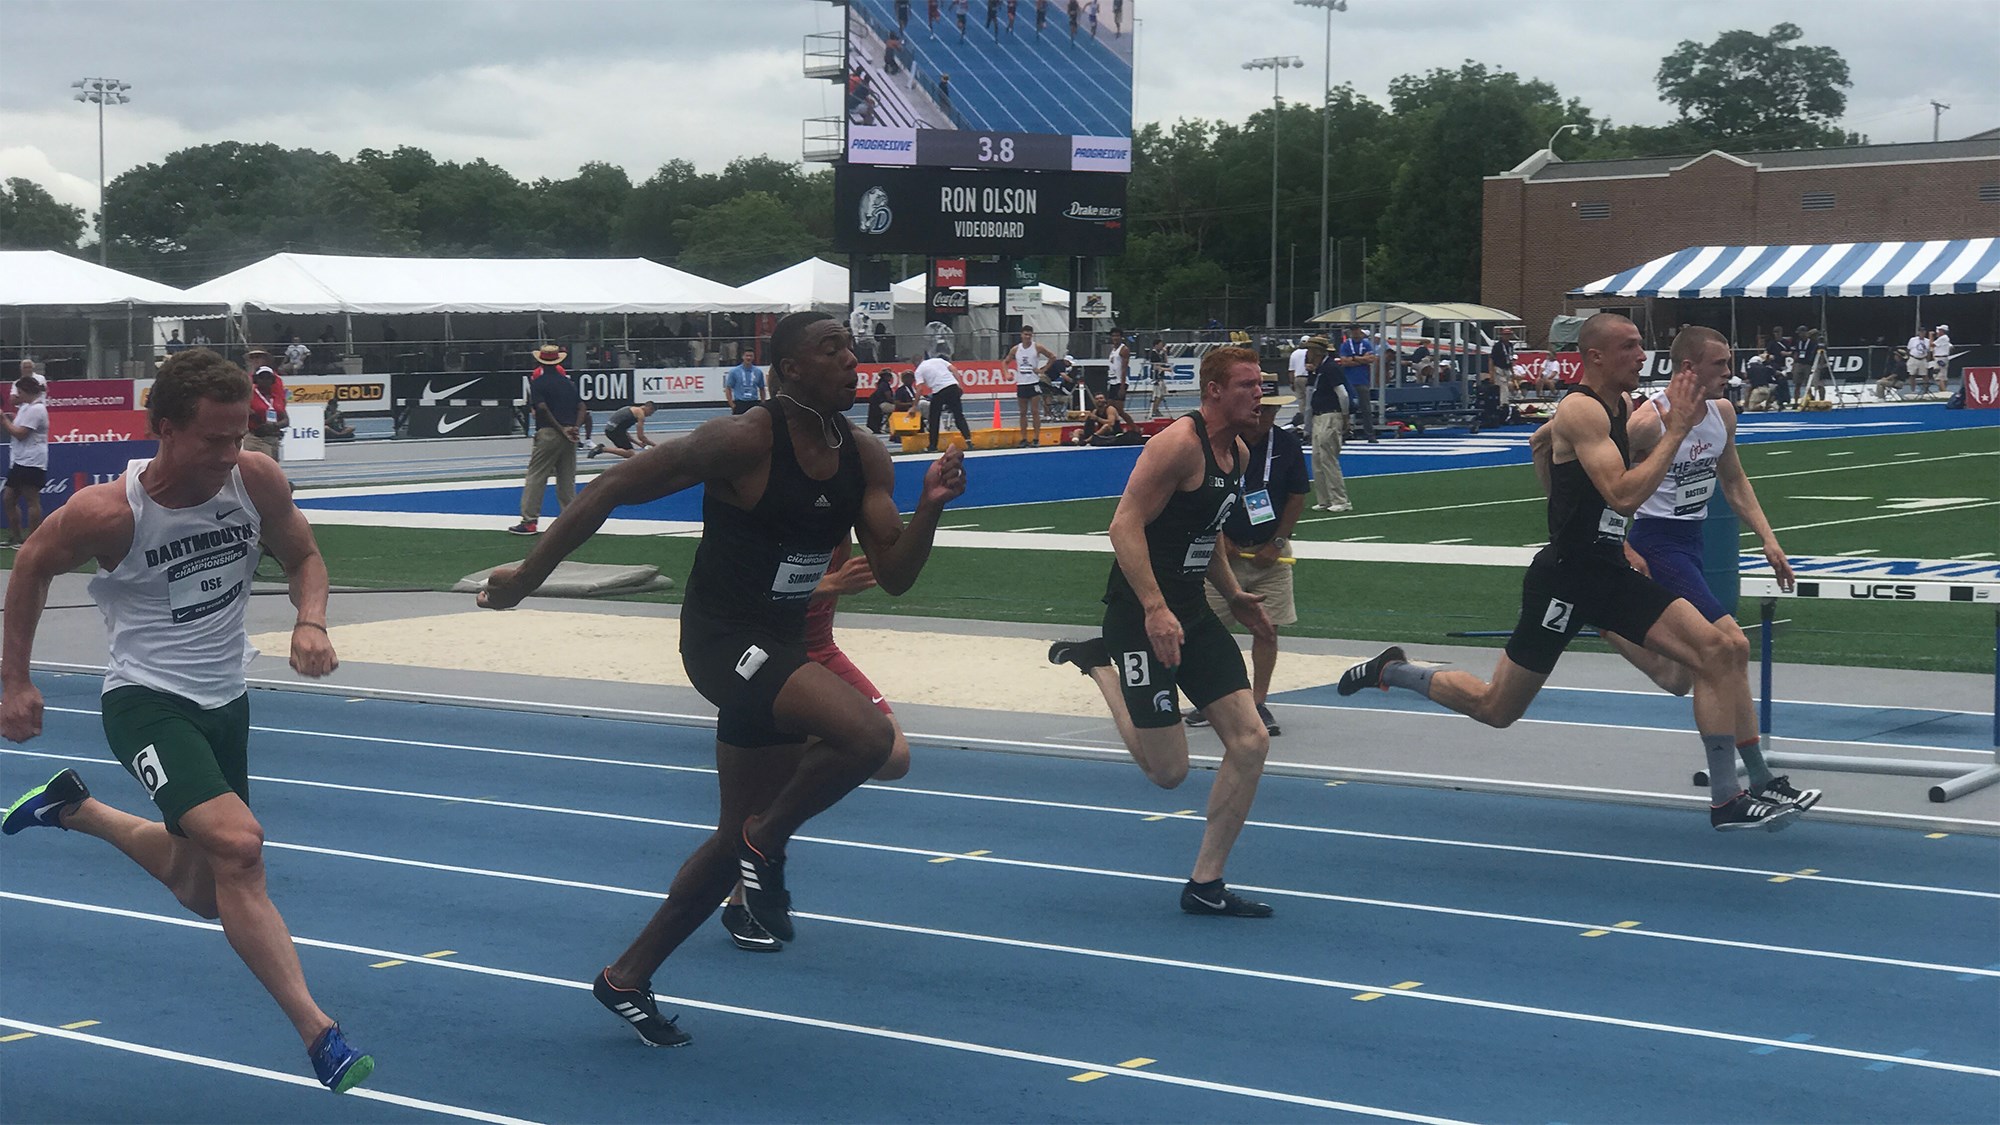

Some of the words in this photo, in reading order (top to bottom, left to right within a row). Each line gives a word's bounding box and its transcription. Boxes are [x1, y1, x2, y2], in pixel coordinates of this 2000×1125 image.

[851, 138, 913, 151] PROGRESSIVE
[978, 137, 1015, 163] 3.8
[1074, 147, 1128, 160] PROGRESSIVE
[941, 187, 977, 213] RON
[982, 188, 1037, 214] OLSON
[1070, 201, 1098, 216] Drake
[1099, 207, 1122, 216] RELAYS
[955, 221, 1024, 239] VIDEOBOARD
[869, 301, 891, 311] EMC
[642, 377, 663, 391] KT
[664, 376, 705, 390] TAPE
[292, 387, 334, 402] Sports
[337, 385, 381, 399] GOLD
[292, 427, 320, 439] Life
[145, 523, 254, 568] DARTMOUTH
[174, 550, 243, 579] CHAMPIONSHIPS
[200, 576, 222, 592] OSE
[1850, 584, 1916, 600] UCS
[1547, 602, 1567, 630] 2
[1128, 653, 1144, 685] 3
[137, 751, 158, 792] 6
